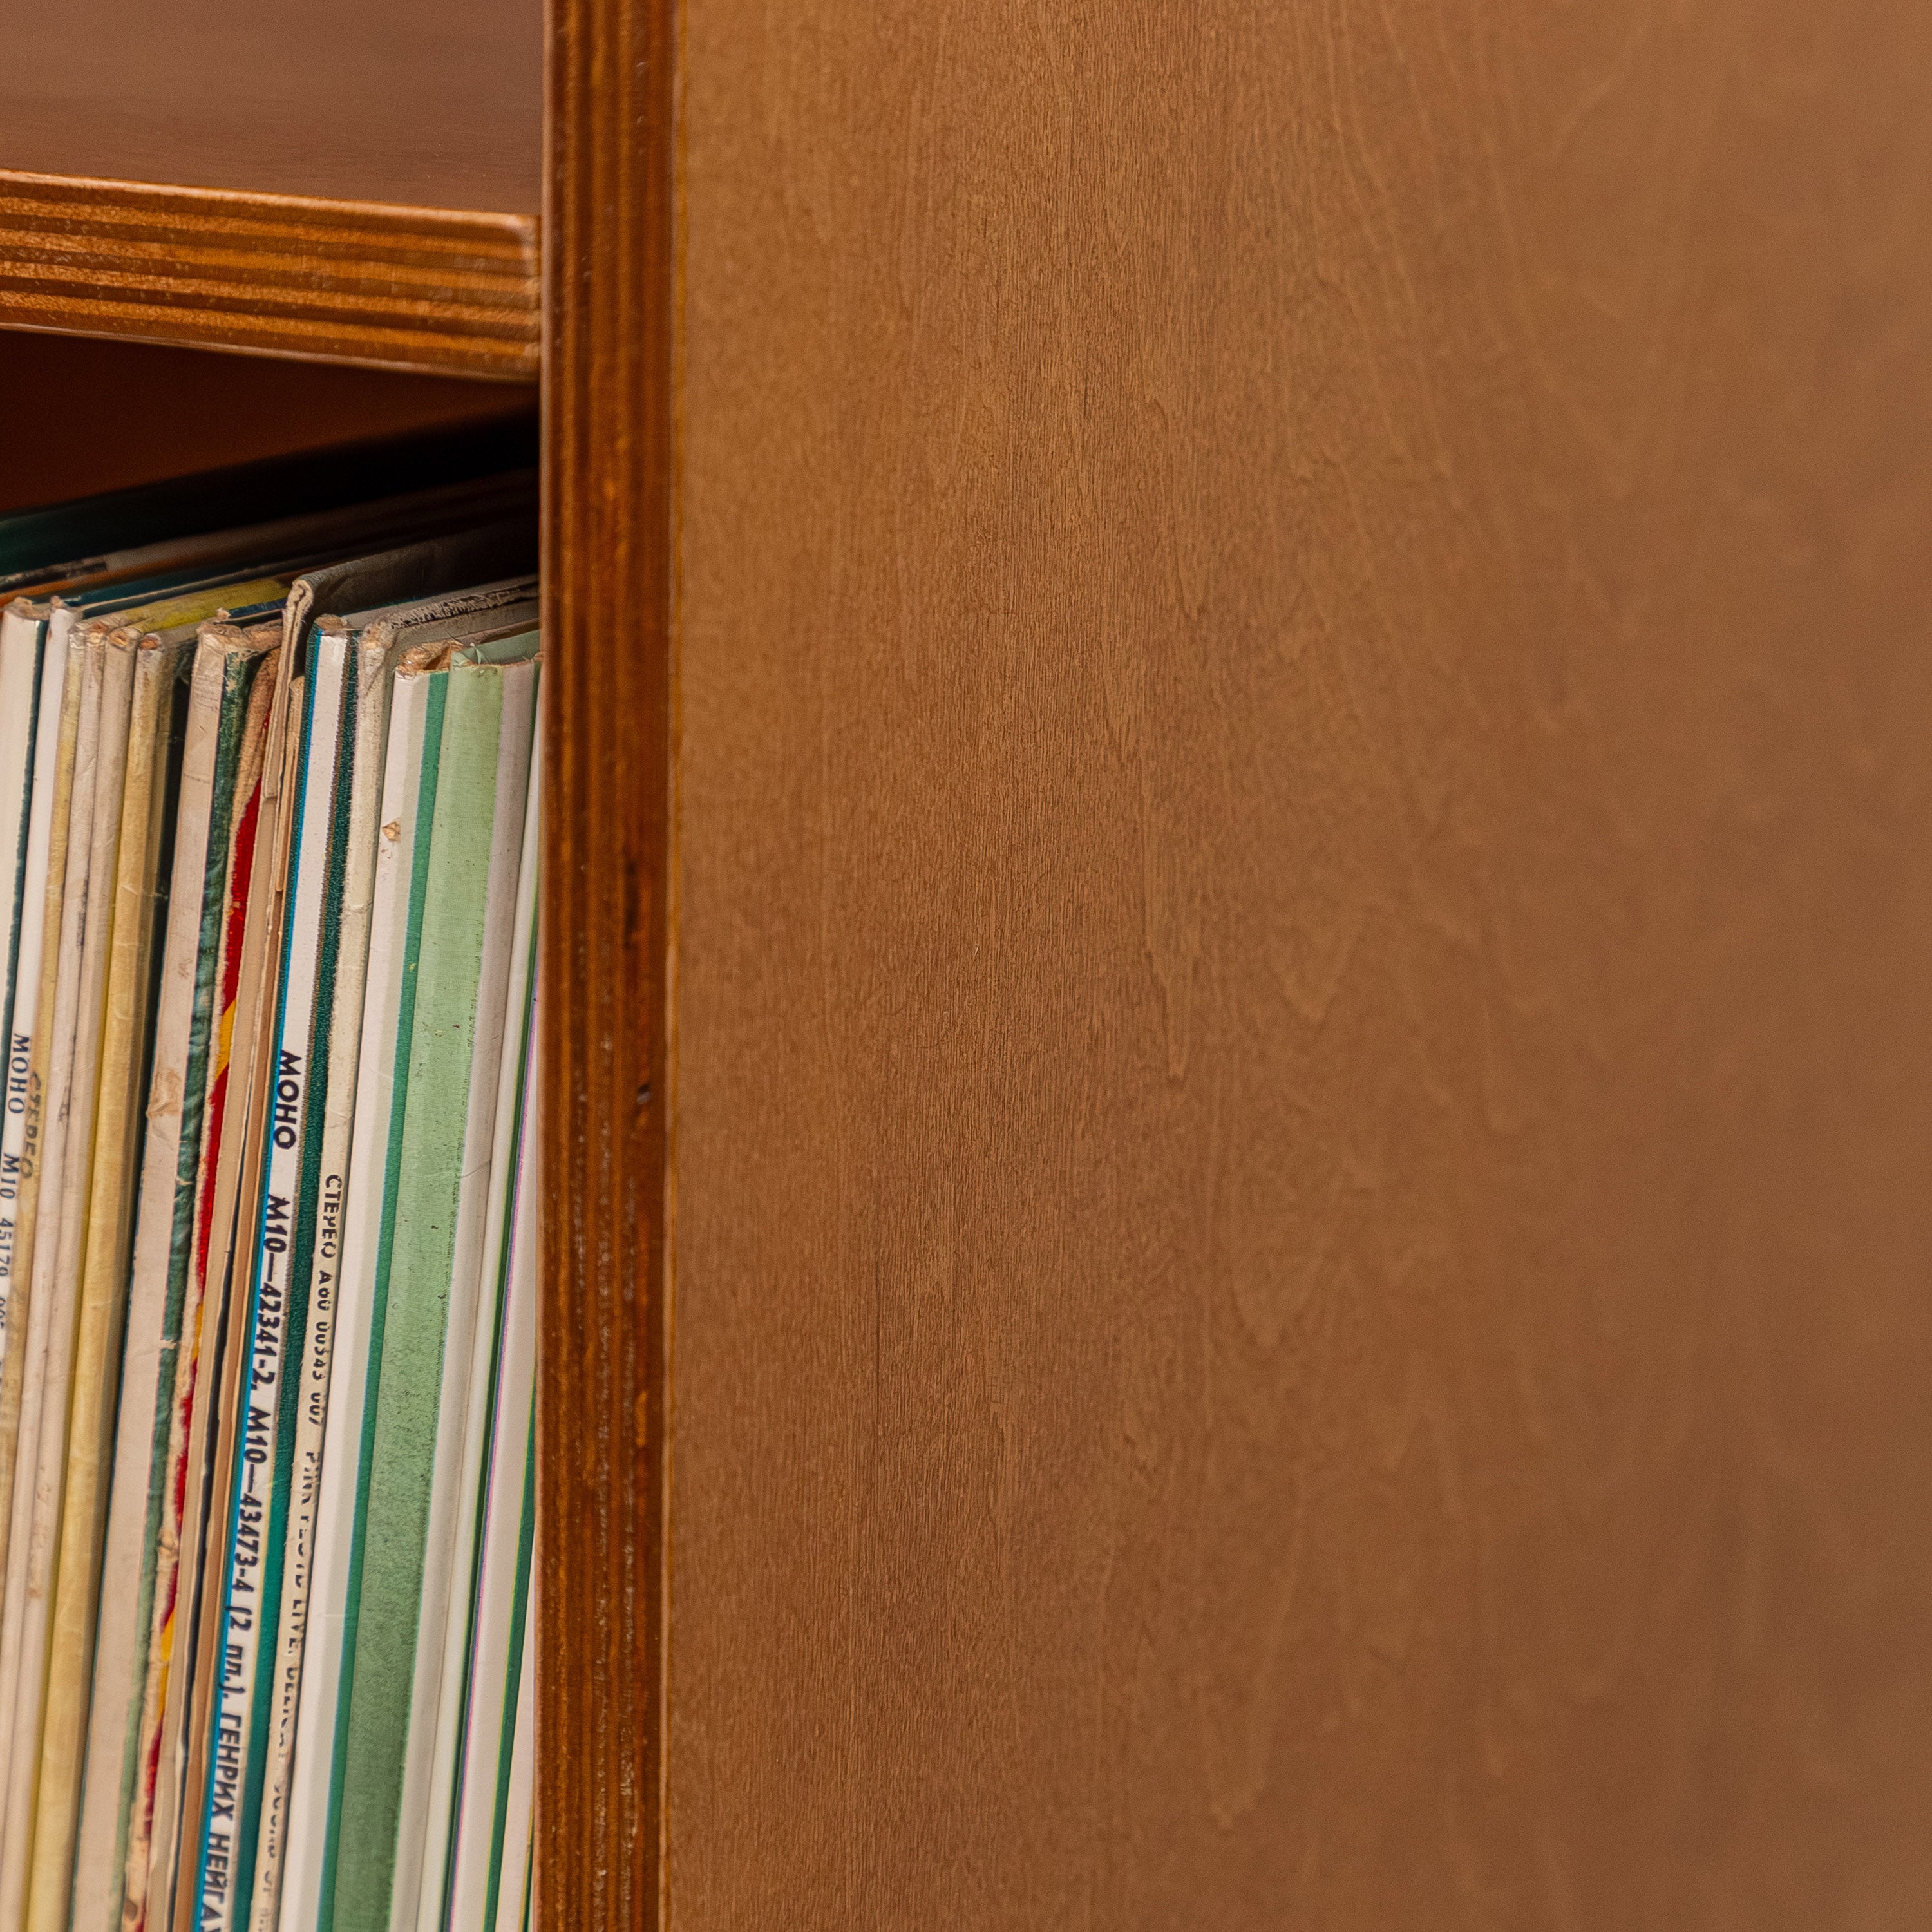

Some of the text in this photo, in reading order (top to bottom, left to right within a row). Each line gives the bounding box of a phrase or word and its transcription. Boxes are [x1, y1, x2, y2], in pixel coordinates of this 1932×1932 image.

[8, 1033, 30, 1114] МОНО
[273, 1049, 301, 1150] МОНО
[0, 1153, 20, 1198] М10
[321, 1174, 342, 1258] СТЕРЕО
[225, 1605, 252, 1631] (2
[212, 1712, 242, 1821] ГЕНРИХ
[200, 1832, 231, 1932] НЕЙГА
